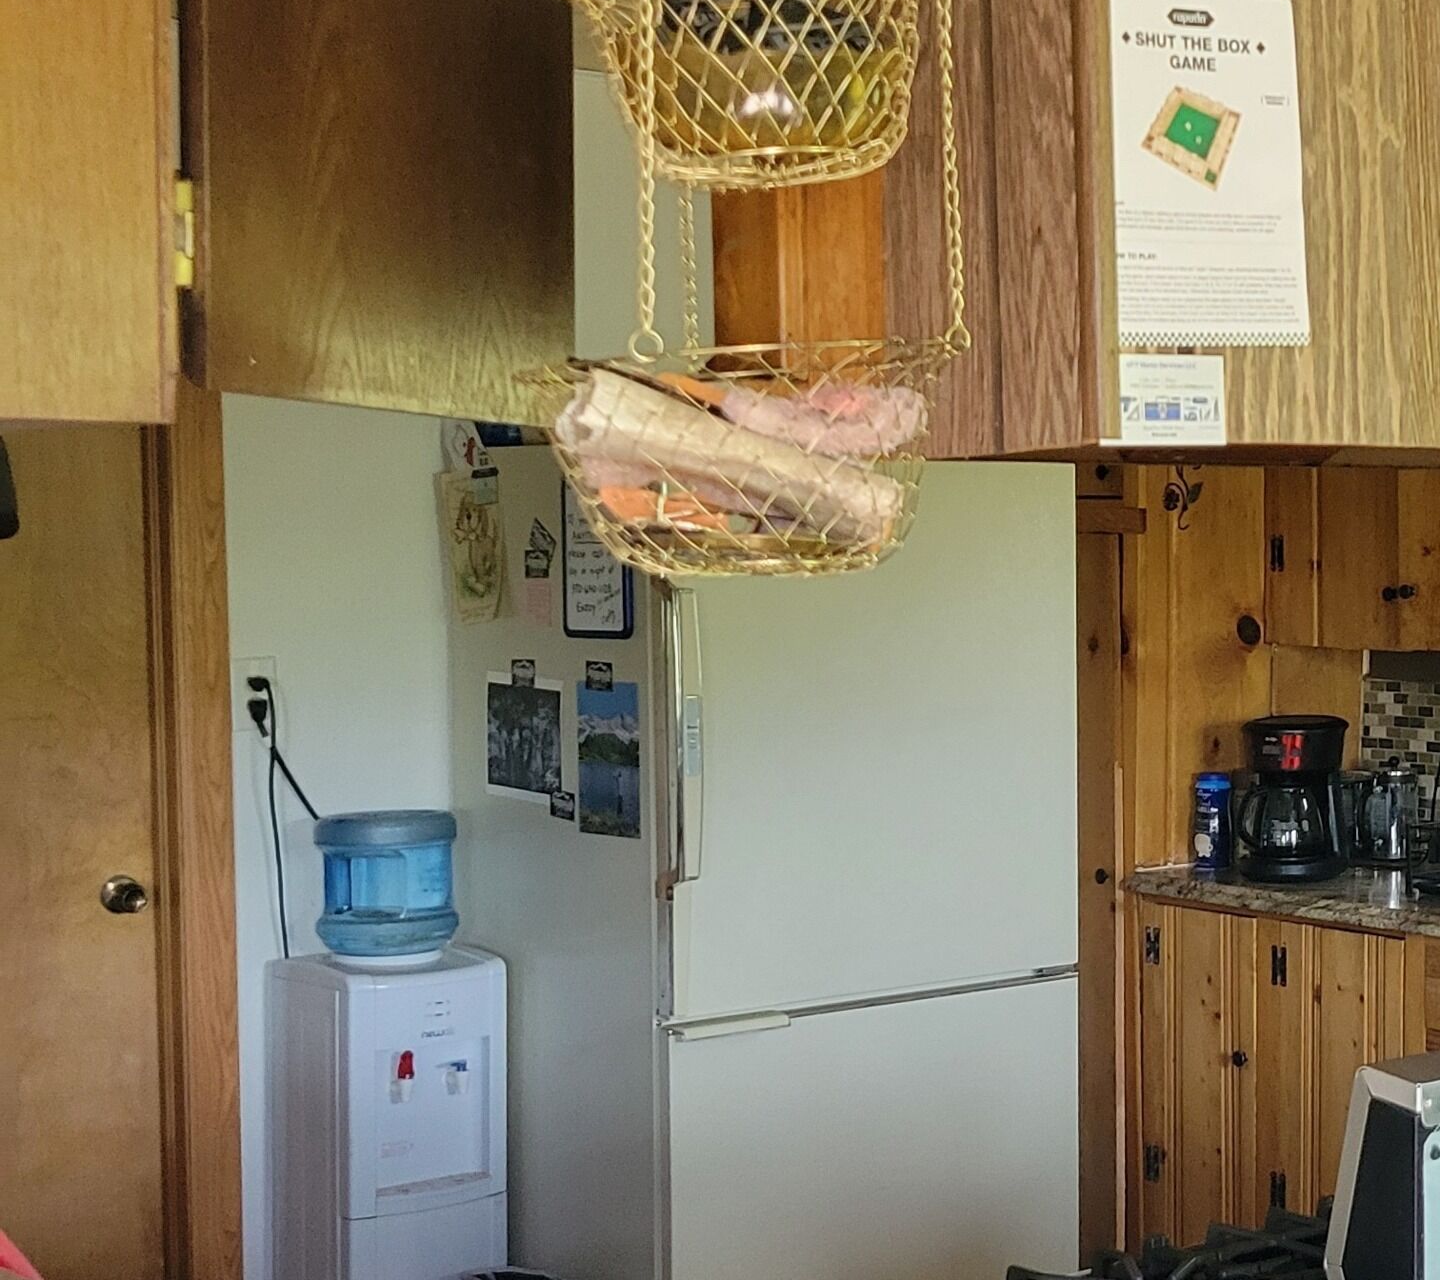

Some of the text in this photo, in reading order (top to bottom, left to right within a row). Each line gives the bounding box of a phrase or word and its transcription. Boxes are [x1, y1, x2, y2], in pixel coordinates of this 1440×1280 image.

[1135, 32, 1251, 54] SHUT THE BOX
[1169, 55, 1217, 72] GAME
